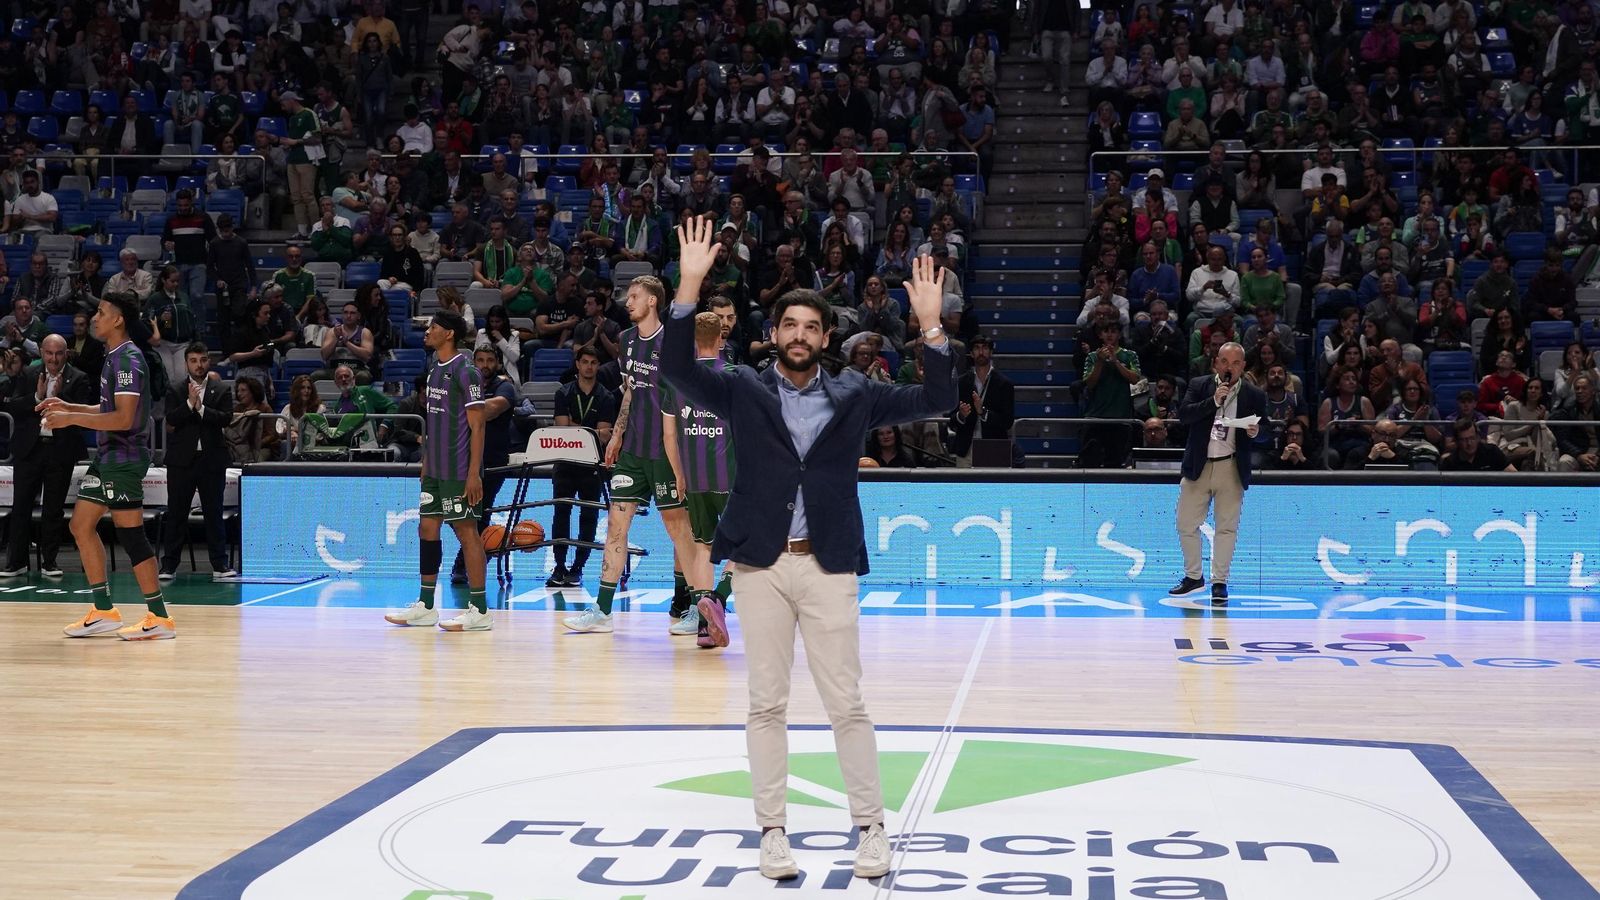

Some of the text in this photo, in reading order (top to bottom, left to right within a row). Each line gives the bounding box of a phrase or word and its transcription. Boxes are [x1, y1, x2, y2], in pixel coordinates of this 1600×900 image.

[539, 437, 583, 449] Wilson
[1174, 638, 1413, 654] liga
[481, 820, 1340, 863] Fundación
